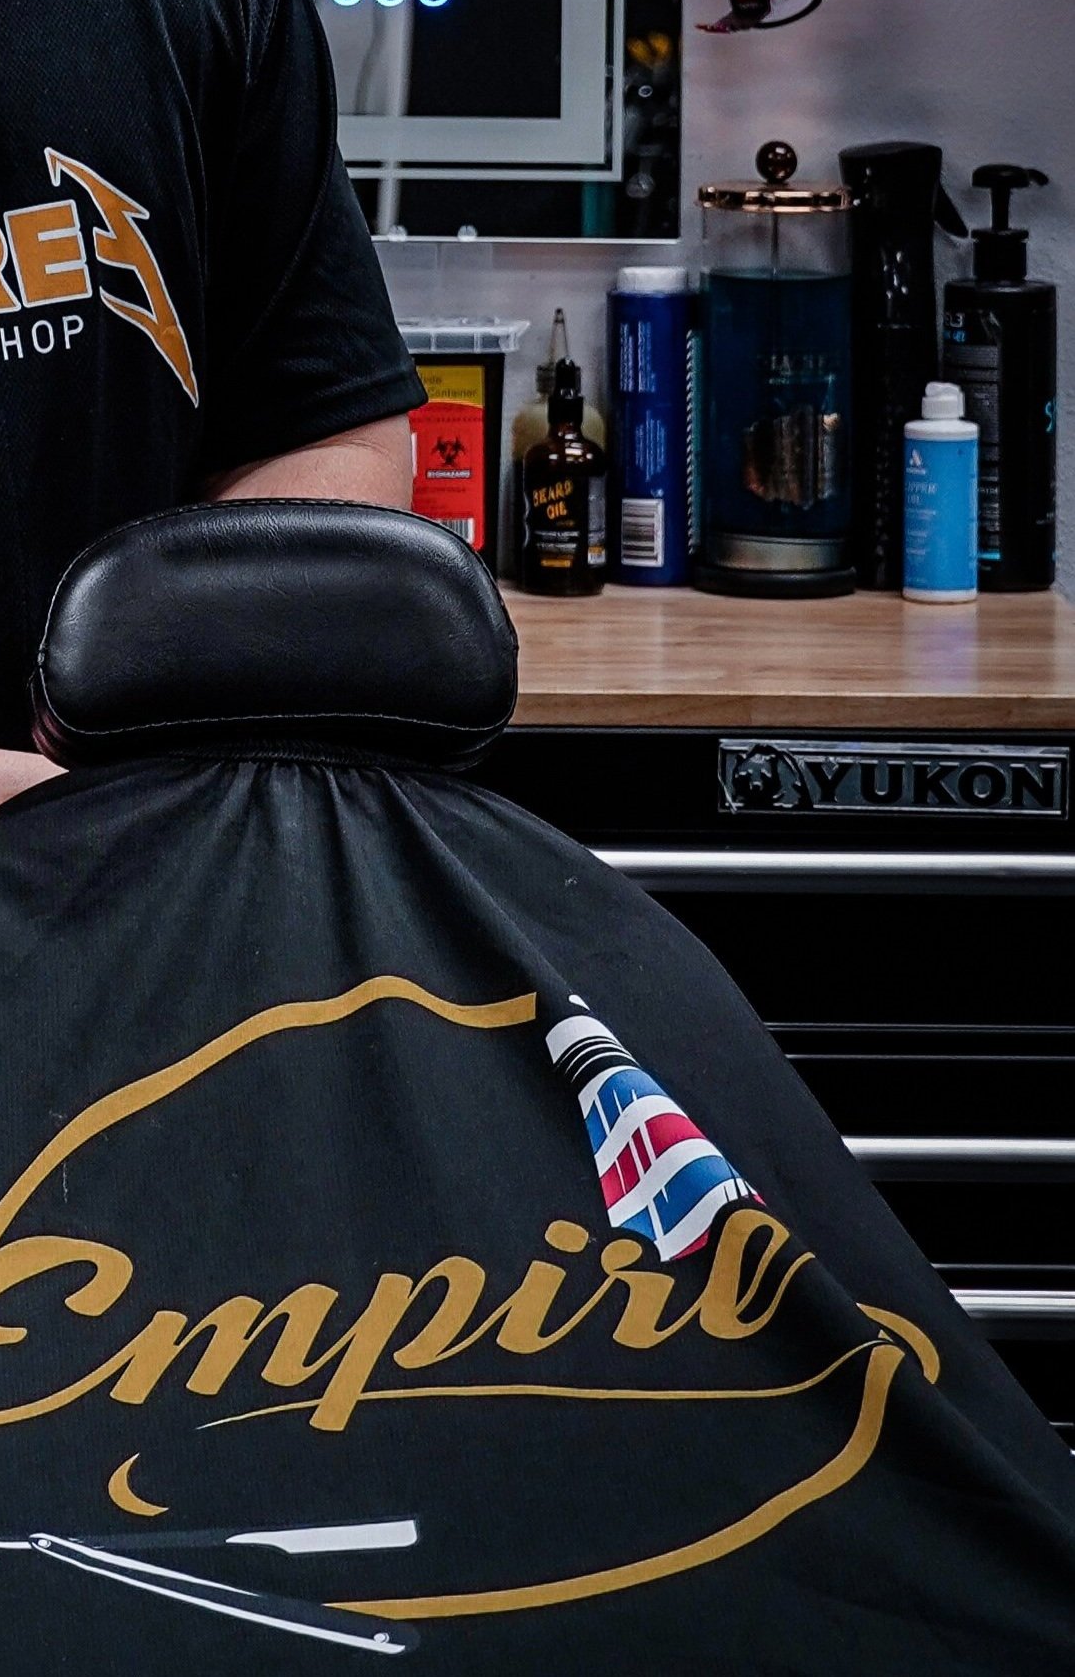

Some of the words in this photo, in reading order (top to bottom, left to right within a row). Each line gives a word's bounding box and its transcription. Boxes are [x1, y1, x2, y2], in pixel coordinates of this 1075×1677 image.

[532, 479, 574, 508] BEARD
[546, 500, 568, 520] OIL
[803, 758, 1062, 810] YUKON
